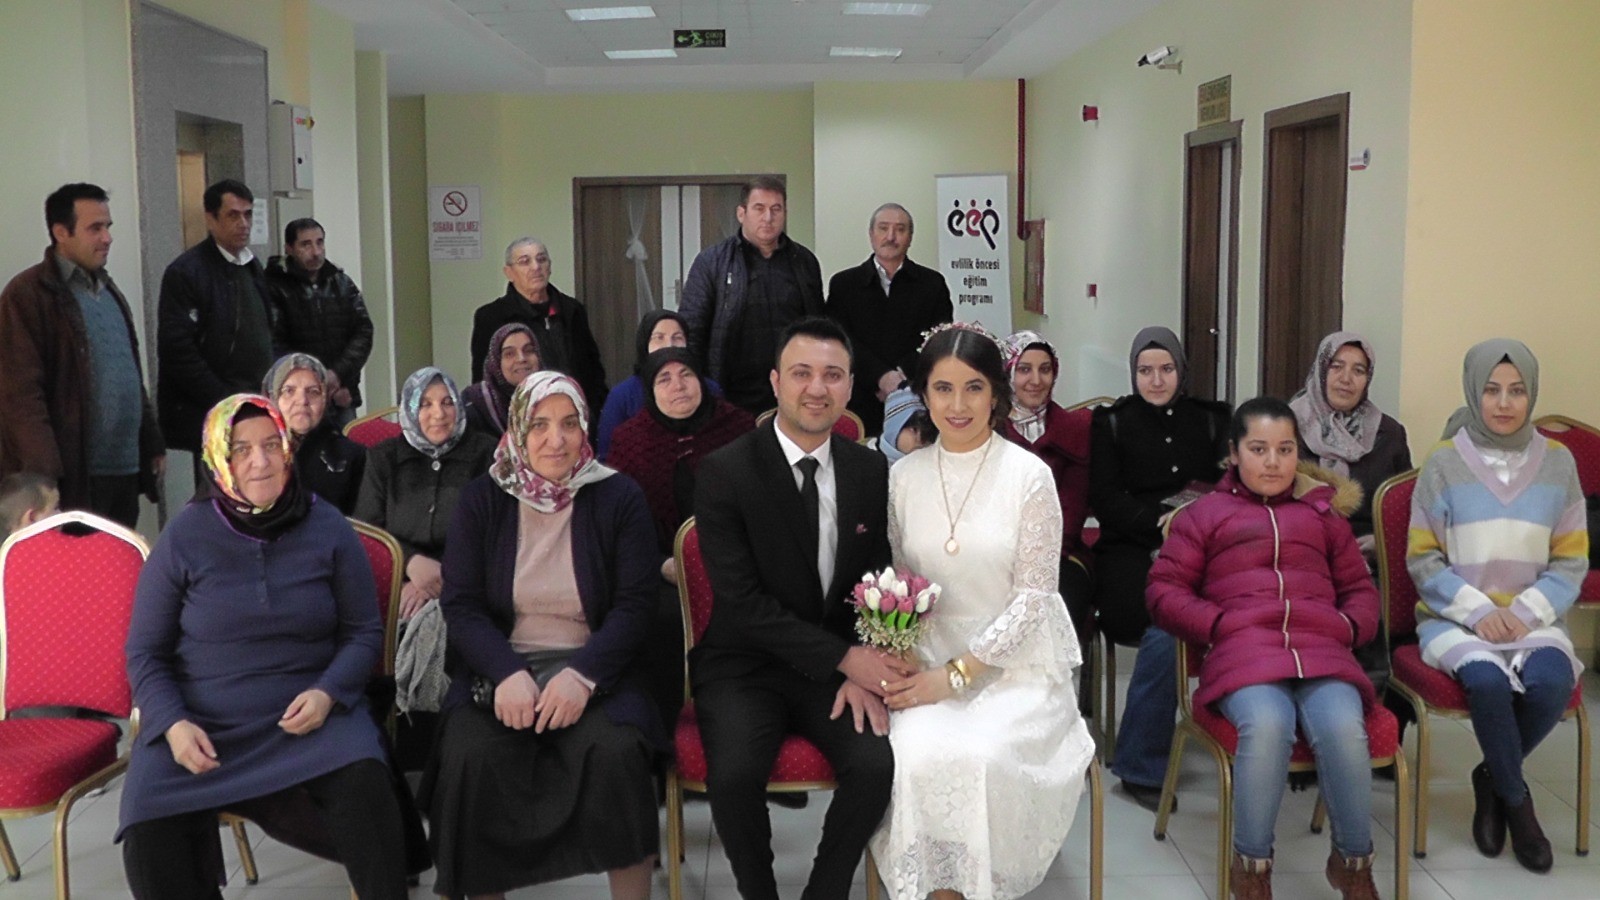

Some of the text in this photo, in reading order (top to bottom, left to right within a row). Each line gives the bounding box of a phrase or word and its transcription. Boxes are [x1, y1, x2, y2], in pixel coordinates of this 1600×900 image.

[951, 258, 1000, 270] evlilik öncesi
[963, 275, 988, 289] eğitim
[959, 294, 993, 306] programı
